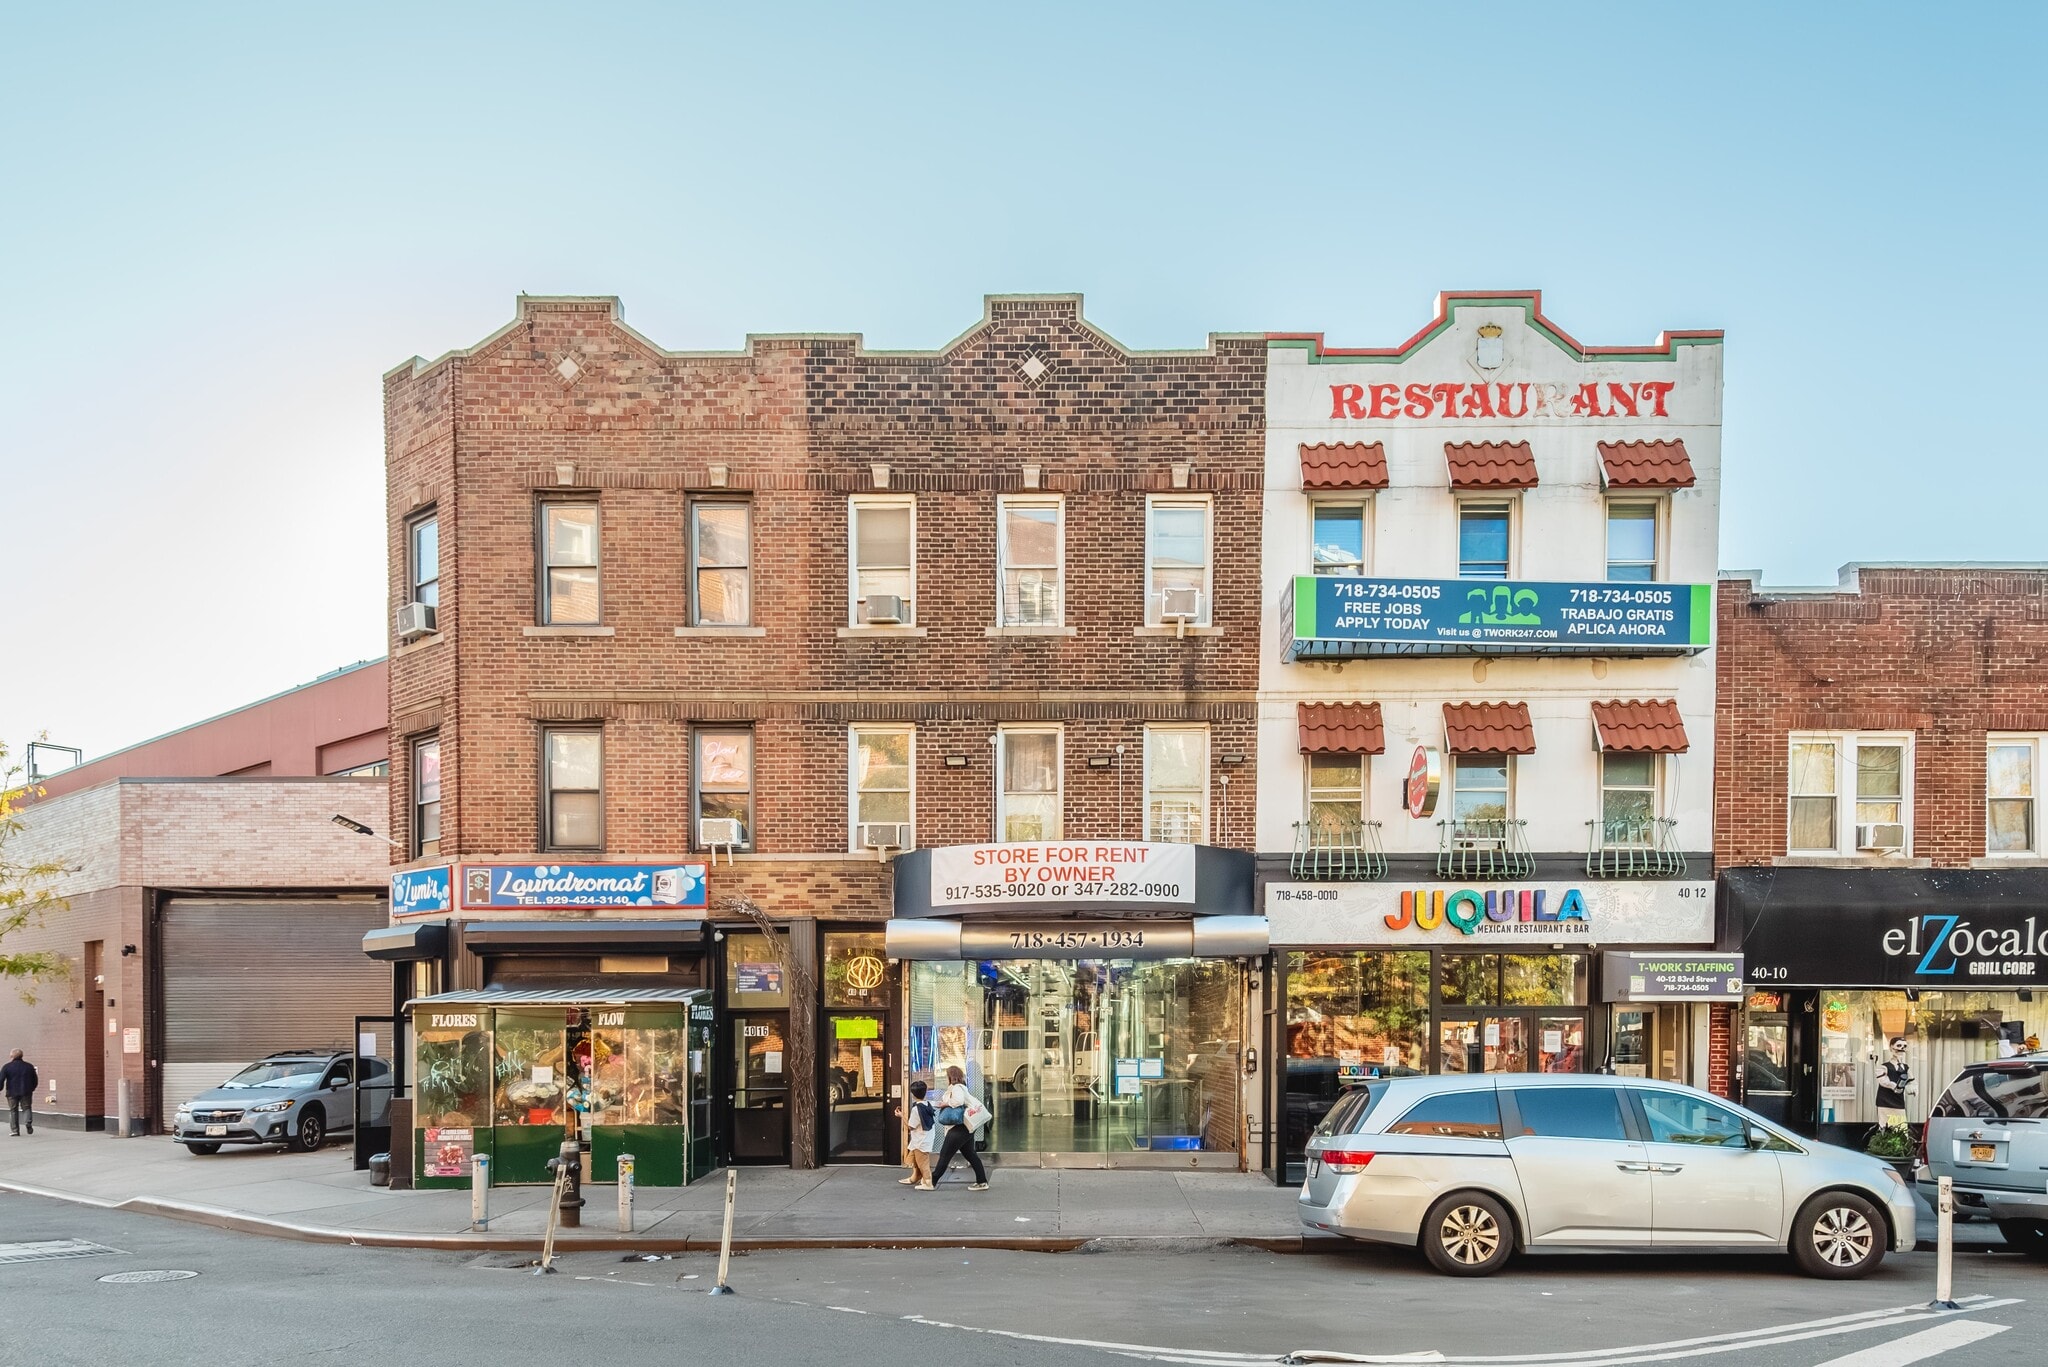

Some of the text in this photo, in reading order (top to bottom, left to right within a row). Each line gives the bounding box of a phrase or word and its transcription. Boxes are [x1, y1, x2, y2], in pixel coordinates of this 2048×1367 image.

[1329, 381, 1675, 420] RESTAURANT
[1334, 583, 1441, 599] 718-734-0505
[1570, 589, 1672, 604] 718-734-0505
[1344, 602, 1422, 615] FREE JOBS
[1560, 608, 1674, 621] TRABAJO GRATIS
[1335, 616, 1431, 630] APPLY TODAY
[1567, 623, 1666, 636] APLICA AHORA
[1437, 627, 1457, 636] Visit
[1459, 629, 1470, 637] us
[1484, 629, 1558, 638] TWORK247.COM
[974, 847, 1149, 865] STORE FOR RENT
[1005, 866, 1116, 883] BY OWNER
[497, 870, 649, 896] Laundromat
[404, 875, 438, 906] Lumi's
[945, 883, 1180, 900] 917-535-9020 or 347-282-0900
[1276, 890, 1338, 901] 718-458-0010
[1678, 887, 1707, 898] 40 12
[517, 895, 629, 905] TEL.929-424-3140
[1384, 889, 1592, 935] JUQUILA
[1477, 924, 1590, 933] MEXICAN RESTAURANT & BAR
[1638, 963, 1735, 972] T-WORK STAFFING
[1751, 967, 1788, 979] 40-10
[1969, 961, 2036, 975] GRILL CORP.
[1655, 975, 1676, 983] 40-12
[1695, 975, 1717, 983] Street
[1749, 996, 1780, 1007] OPEN
[431, 1014, 477, 1027] FLORES
[598, 1012, 625, 1026] FLOW
[1337, 1066, 1379, 1077] JUQUILA
